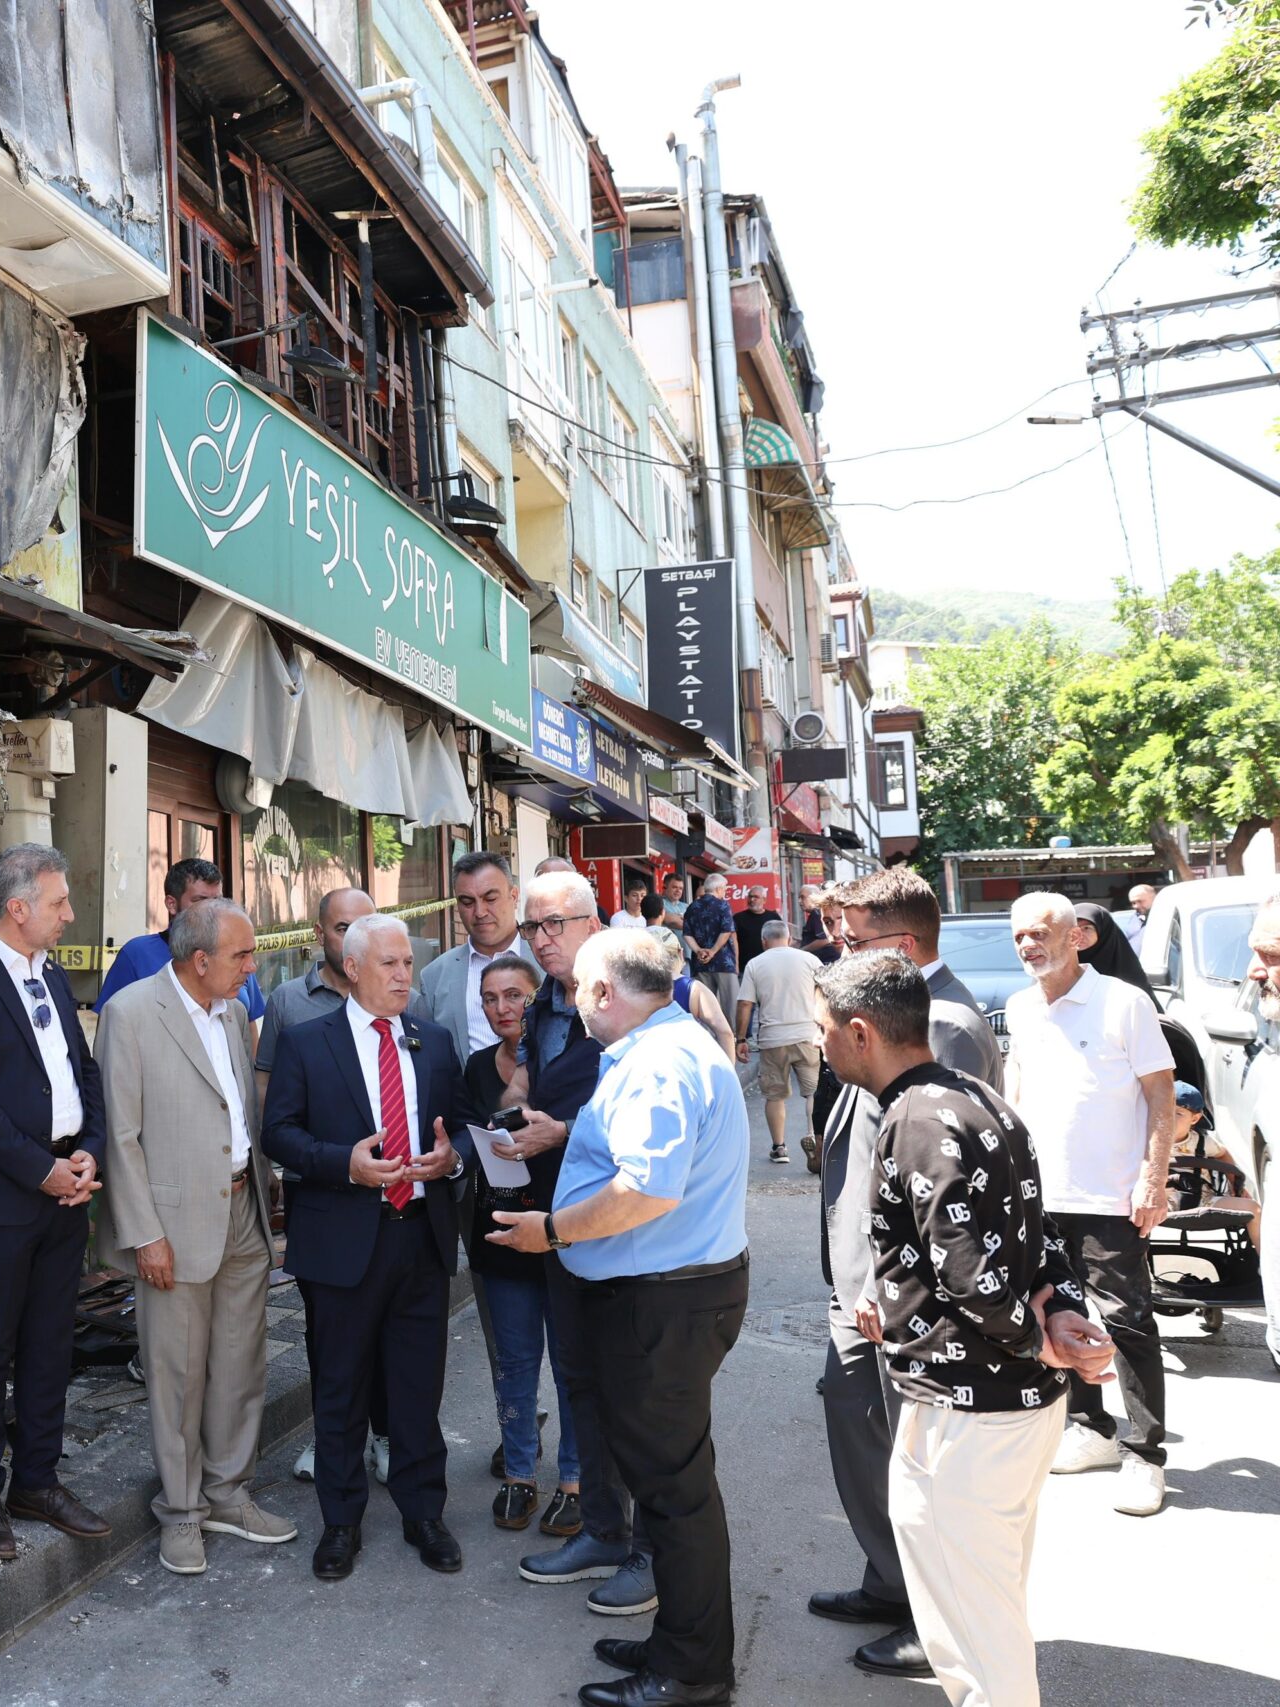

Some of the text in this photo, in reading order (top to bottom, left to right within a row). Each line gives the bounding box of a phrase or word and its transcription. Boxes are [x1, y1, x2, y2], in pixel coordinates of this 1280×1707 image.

[281, 448, 455, 646] YEŞİL SOFRA
[661, 568, 716, 582] SETBAŞI
[375, 626, 457, 703] EV YEMEKLERİ
[675, 586, 704, 730] PLAYSTATIO
[538, 720, 560, 748] MEHMET
[560, 732, 573, 754] USTA
[595, 728, 627, 769] SETBAŞI
[596, 758, 630, 799] İLETİŞİM
[54, 948, 83, 967] OLİS
